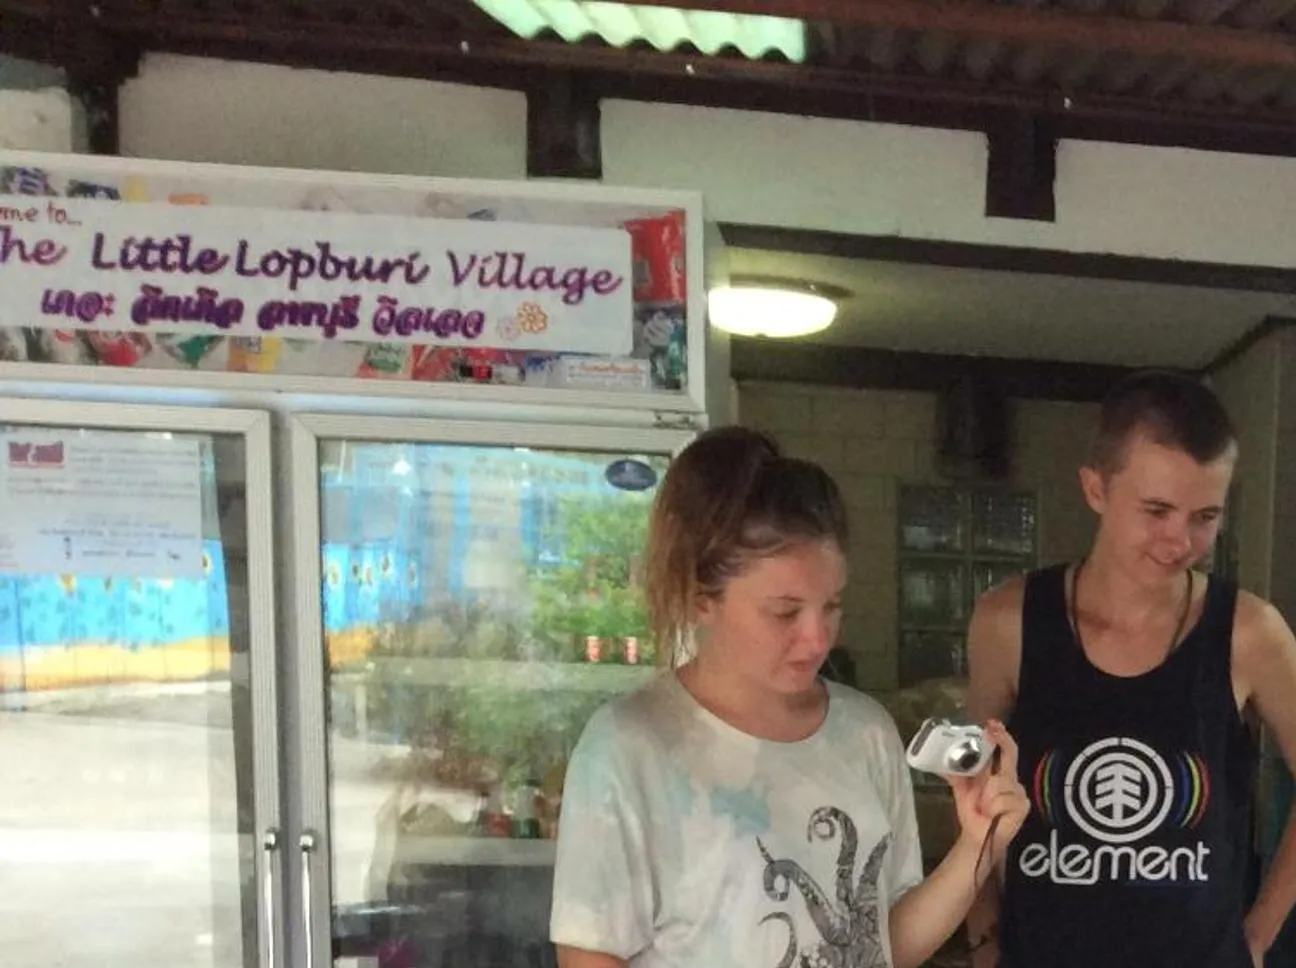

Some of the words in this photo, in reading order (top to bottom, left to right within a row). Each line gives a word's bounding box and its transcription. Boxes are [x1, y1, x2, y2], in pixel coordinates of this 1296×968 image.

[91, 232, 230, 274] Little
[235, 239, 430, 291] Lopburi
[447, 249, 622, 305] Village
[1019, 829, 1211, 885] element
